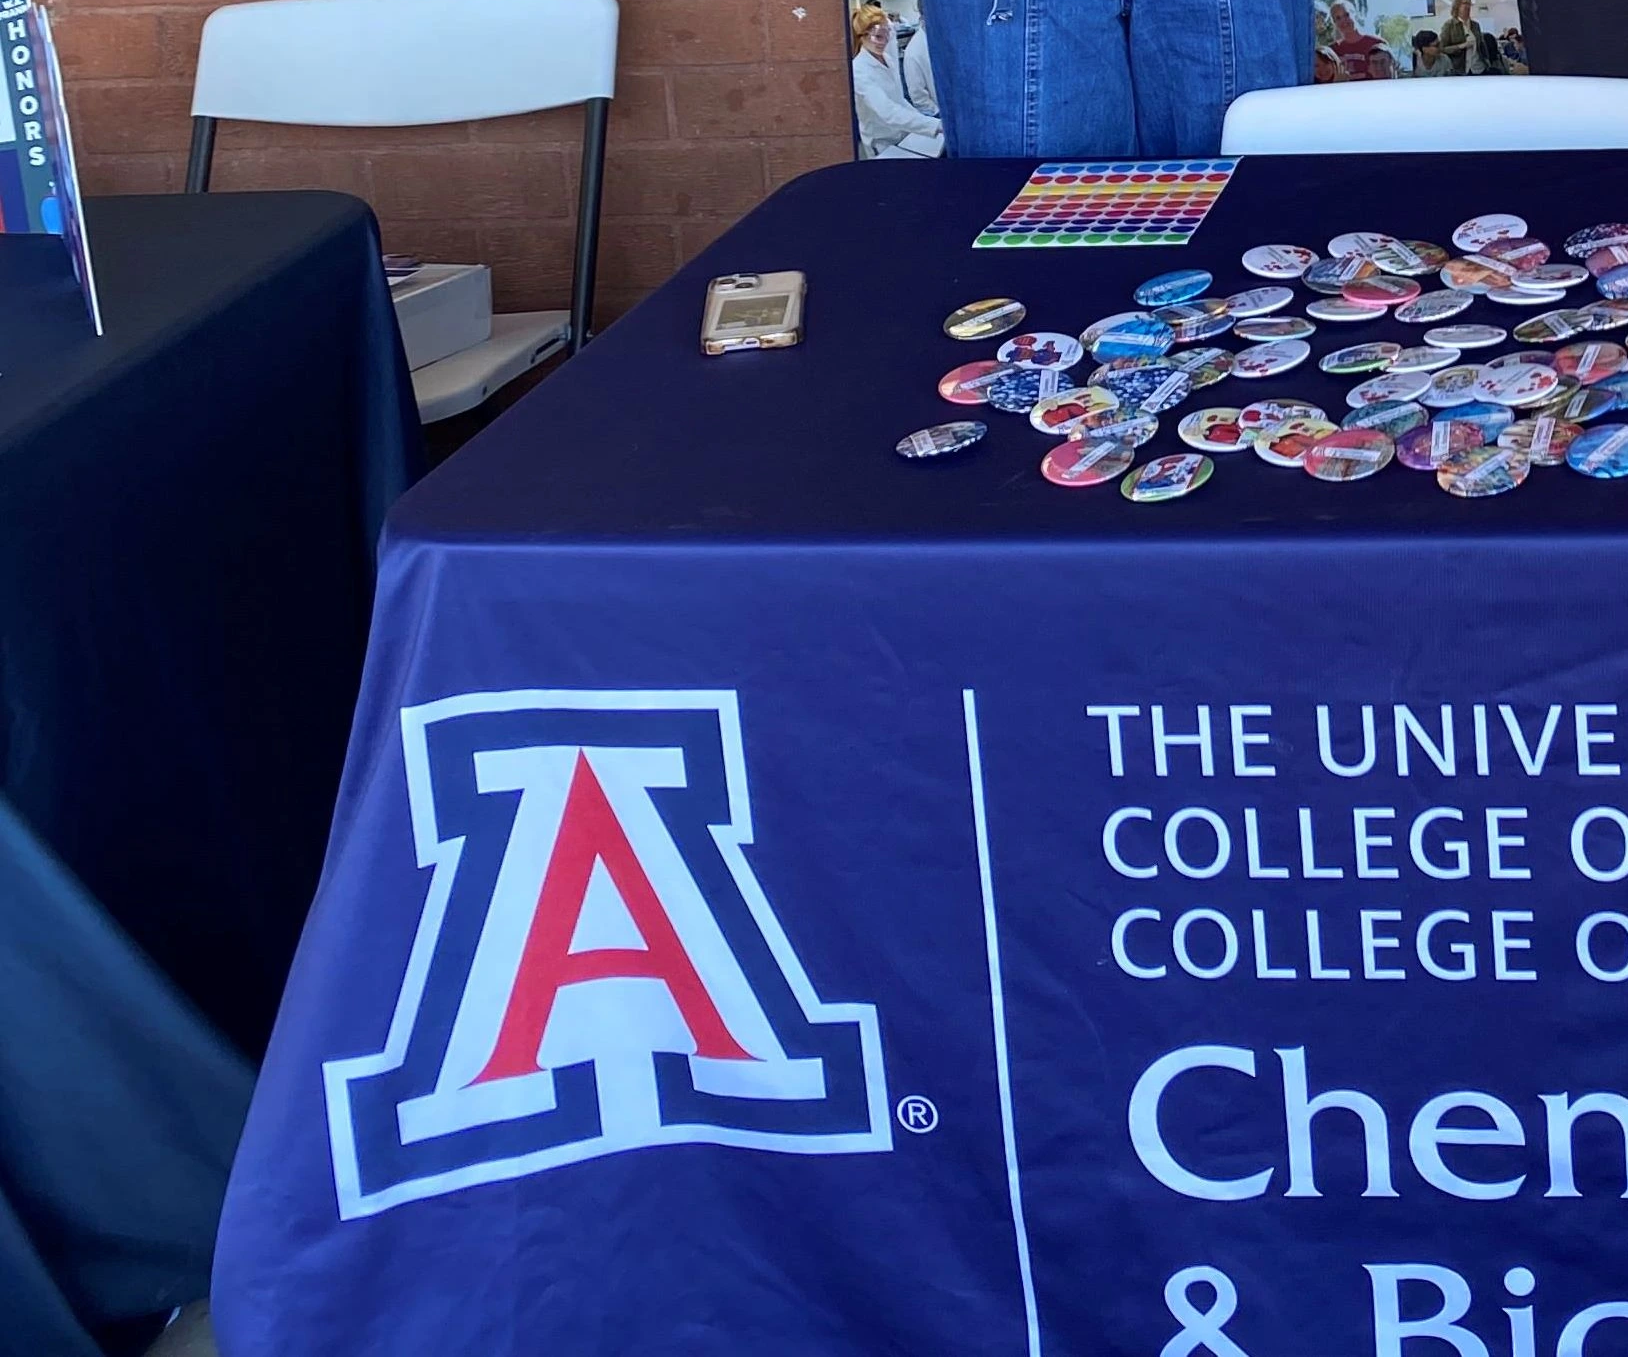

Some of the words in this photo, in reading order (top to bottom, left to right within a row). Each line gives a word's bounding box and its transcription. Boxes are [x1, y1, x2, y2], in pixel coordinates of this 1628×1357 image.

[1086, 702, 1276, 778] THE
[1101, 806, 1533, 881] COLLEGE
[322, 688, 893, 1221] A
[1110, 907, 1537, 982] COLLEGE
